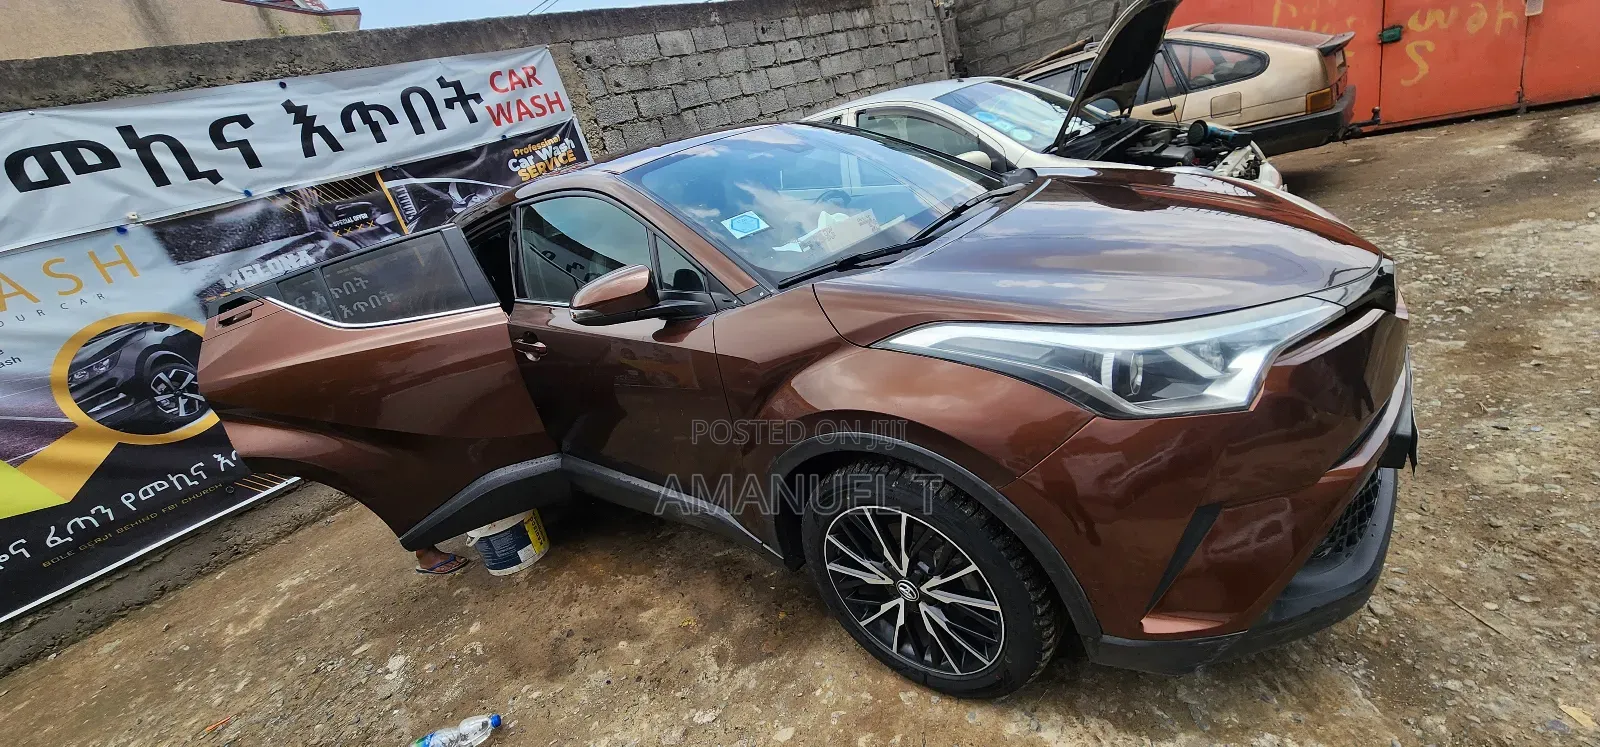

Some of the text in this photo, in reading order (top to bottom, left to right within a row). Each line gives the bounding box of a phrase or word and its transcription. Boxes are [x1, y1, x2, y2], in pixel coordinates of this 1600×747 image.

[489, 65, 543, 94] CAR
[485, 91, 566, 127] WASH
[4, 75, 484, 193] መኪና እጥበት
[508, 137, 576, 172] Car Wash
[517, 149, 577, 181] SERVICE
[60, 293, 106, 310] CAR
[120, 462, 208, 511] የመኪና
[42, 550, 75, 568] BOLE
[116, 512, 158, 534] BEHIND
[181, 483, 223, 505] CHURCH
